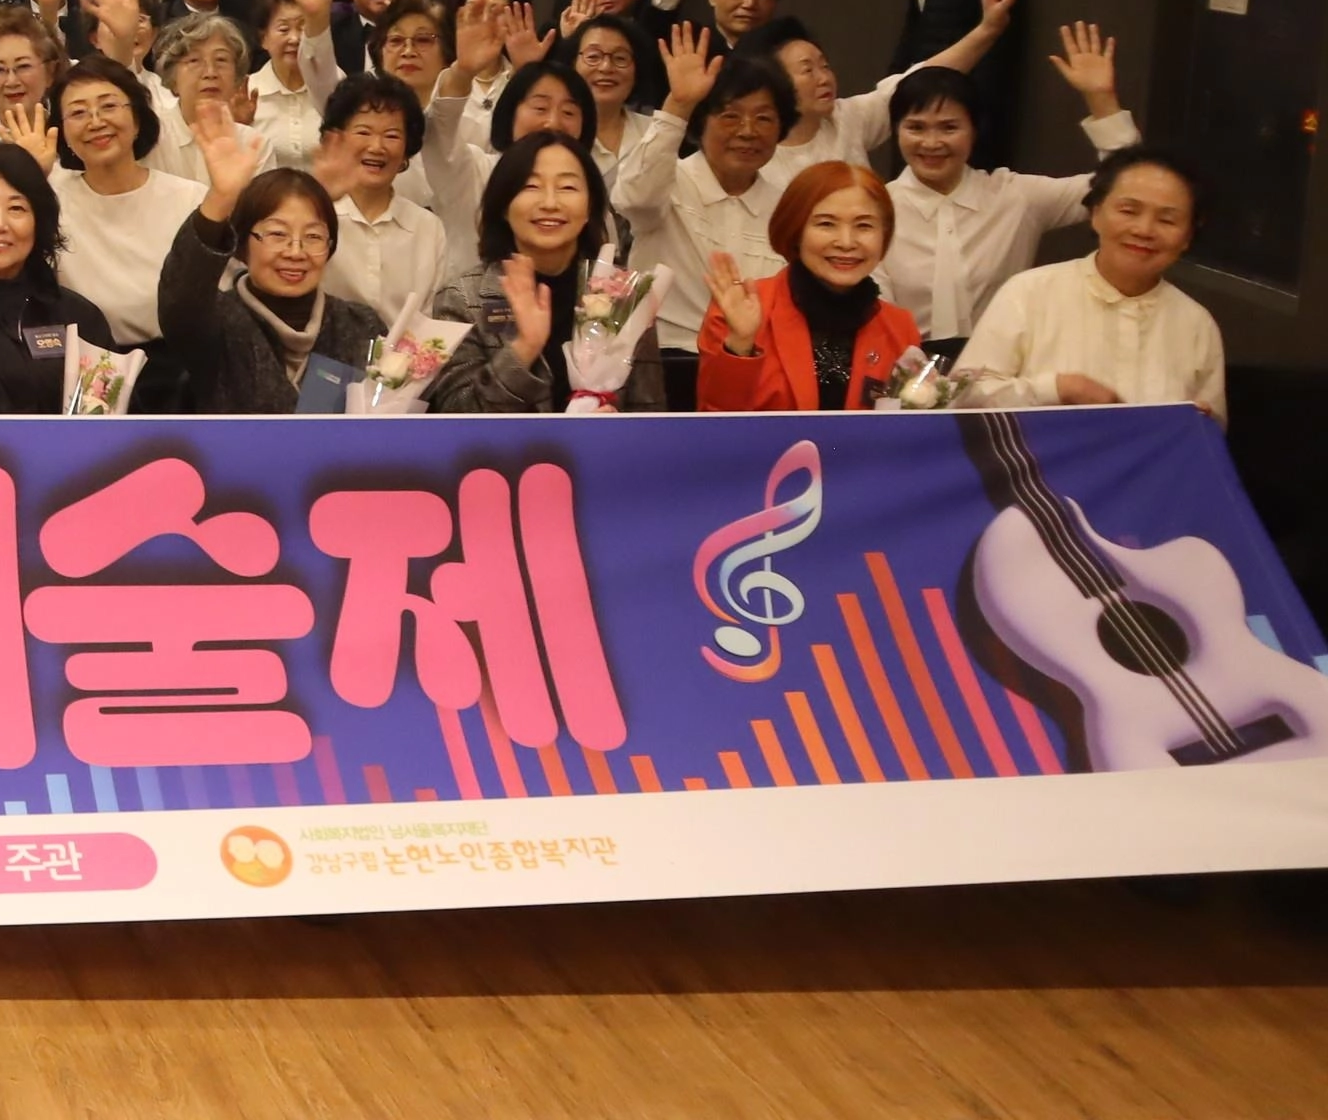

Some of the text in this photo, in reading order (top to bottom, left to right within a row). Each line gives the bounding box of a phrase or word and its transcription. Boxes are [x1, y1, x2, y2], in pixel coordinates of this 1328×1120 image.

[3, 840, 84, 884] 주관
[305, 836, 621, 875] 강남구립 논현노인종합복지관
